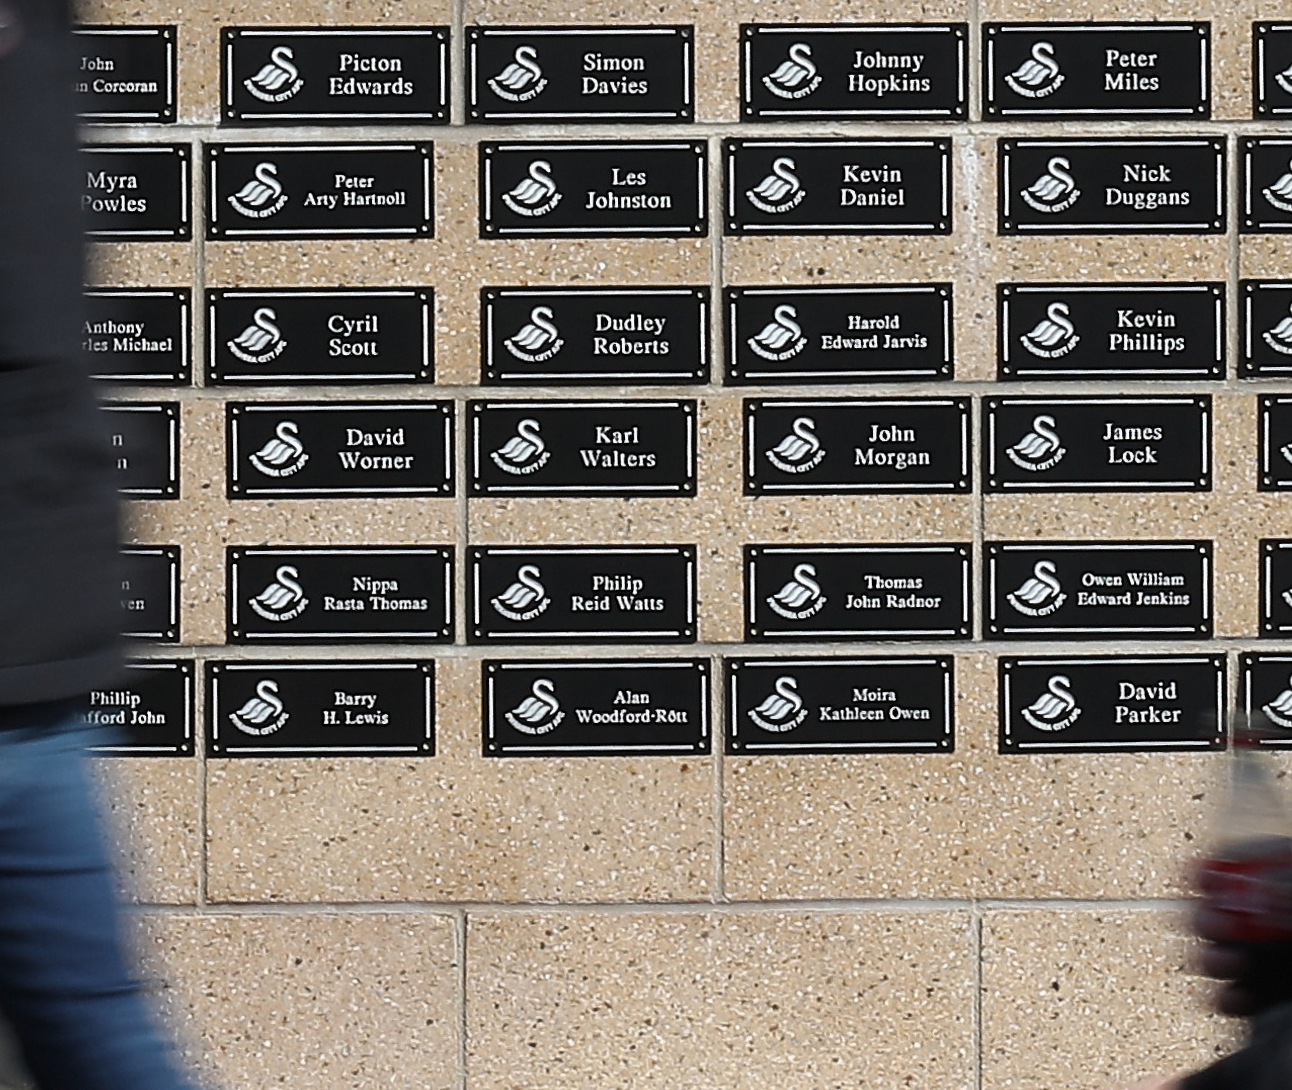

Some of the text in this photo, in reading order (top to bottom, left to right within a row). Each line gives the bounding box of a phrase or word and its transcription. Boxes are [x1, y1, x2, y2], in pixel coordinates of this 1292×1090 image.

[80, 56, 115, 72] John
[339, 53, 402, 72] Picton
[583, 53, 645, 71] Simon
[853, 50, 924, 73] Johnny
[1106, 49, 1158, 68] Peter
[92, 79, 159, 94] Corcoran
[329, 77, 413, 96] Edwards
[582, 76, 648, 94] Davies
[848, 73, 931, 97] Hopkins
[1104, 72, 1159, 91] Miles
[87, 171, 138, 193] Myra
[334, 174, 375, 189] Peter
[611, 168, 647, 186] Les
[843, 164, 902, 183] Kevin
[1123, 164, 1171, 183] Nick
[585, 191, 672, 209] Johnston
[840, 187, 905, 206] Daniel
[1105, 187, 1190, 210] Duggans
[327, 314, 378, 337] Cyril
[595, 313, 666, 336] Dudley
[847, 314, 900, 330] Harold
[1117, 309, 1176, 328] Kevin
[112, 338, 173, 353] Michael
[328, 338, 378, 356] Scott
[593, 337, 669, 355] Roberts
[1109, 332, 1185, 356] Phillips
[346, 428, 405, 447] David
[595, 426, 639, 444] Karl
[868, 424, 915, 443] John
[1102, 423, 1163, 441] James
[338, 451, 414, 470] Worner
[579, 449, 656, 468] Walters
[854, 448, 930, 470] Morgan
[1108, 445, 1158, 464] Lock
[352, 576, 399, 595] Nippa
[592, 575, 643, 595] Philip
[863, 575, 923, 590] Thomas
[323, 596, 428, 611] Rasta Thomas
[571, 593, 664, 611] Reid Watts
[845, 593, 942, 609] John Radnor
[90, 690, 142, 709] Phillip
[334, 691, 377, 709] Barry
[613, 690, 650, 705] Alan
[852, 687, 897, 702] Moira
[1118, 681, 1177, 701] David
[129, 710, 167, 725] John
[819, 705, 930, 721] Kathleen Owen
[1115, 705, 1182, 724] Parker
